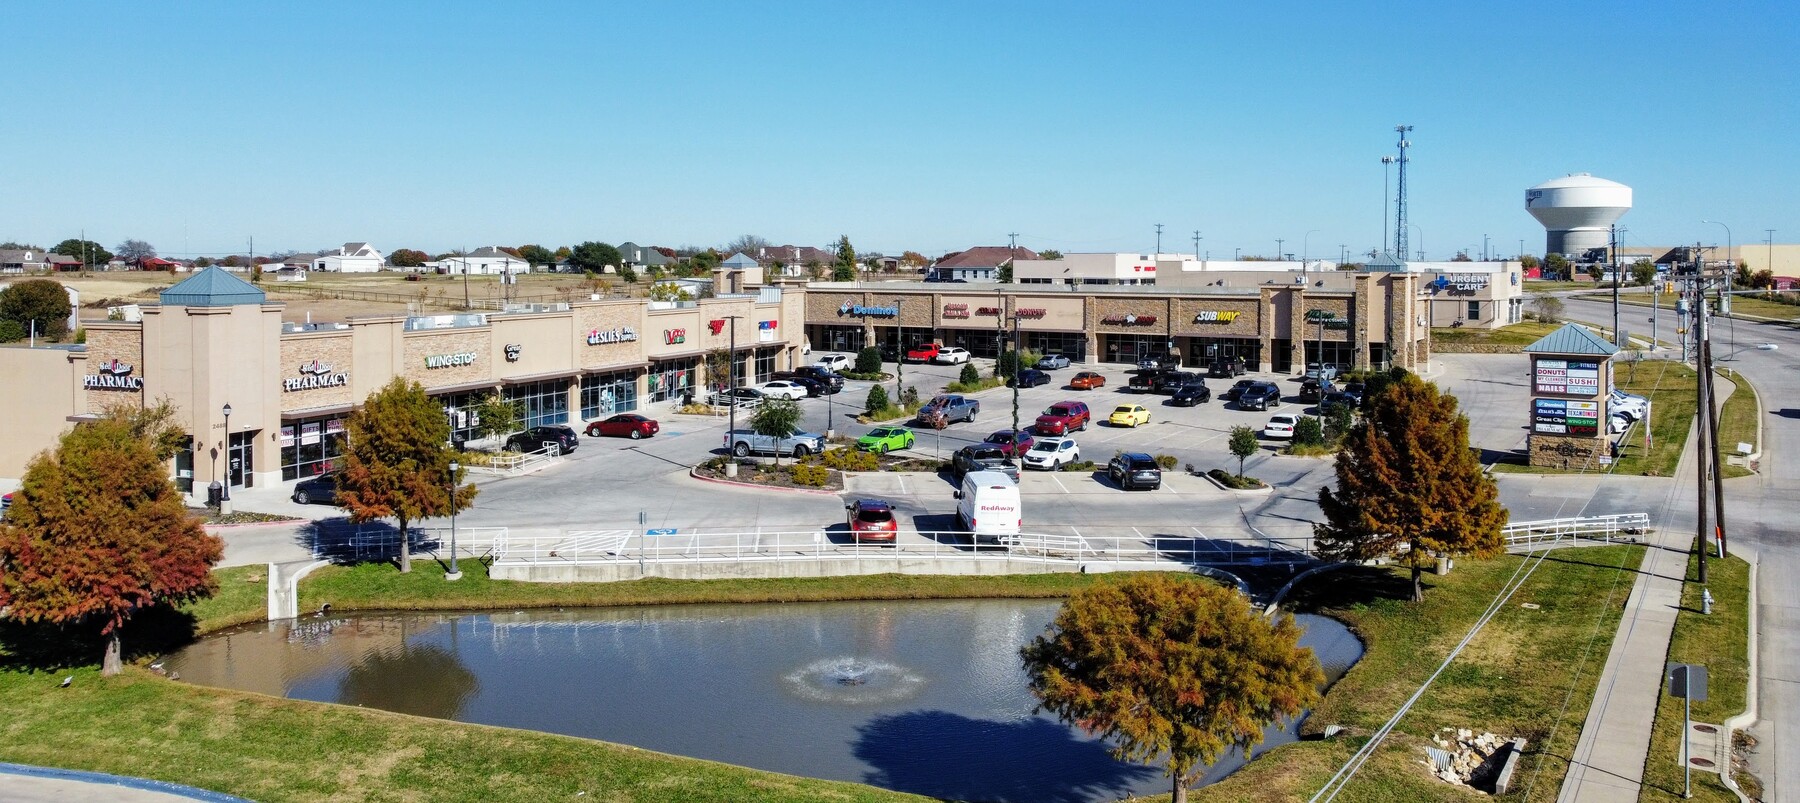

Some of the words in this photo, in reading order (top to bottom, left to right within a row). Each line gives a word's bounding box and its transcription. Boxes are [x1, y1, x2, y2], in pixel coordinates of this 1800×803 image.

[1450, 275, 1490, 283] URGENT
[853, 299, 899, 316] Domino's
[1018, 308, 1046, 316] DONUTS
[1196, 311, 1241, 321] SUBWAY
[590, 329, 620, 344] LESLIE'S
[285, 372, 350, 390] PHARMACY
[302, 425, 319, 434] GIFTS
